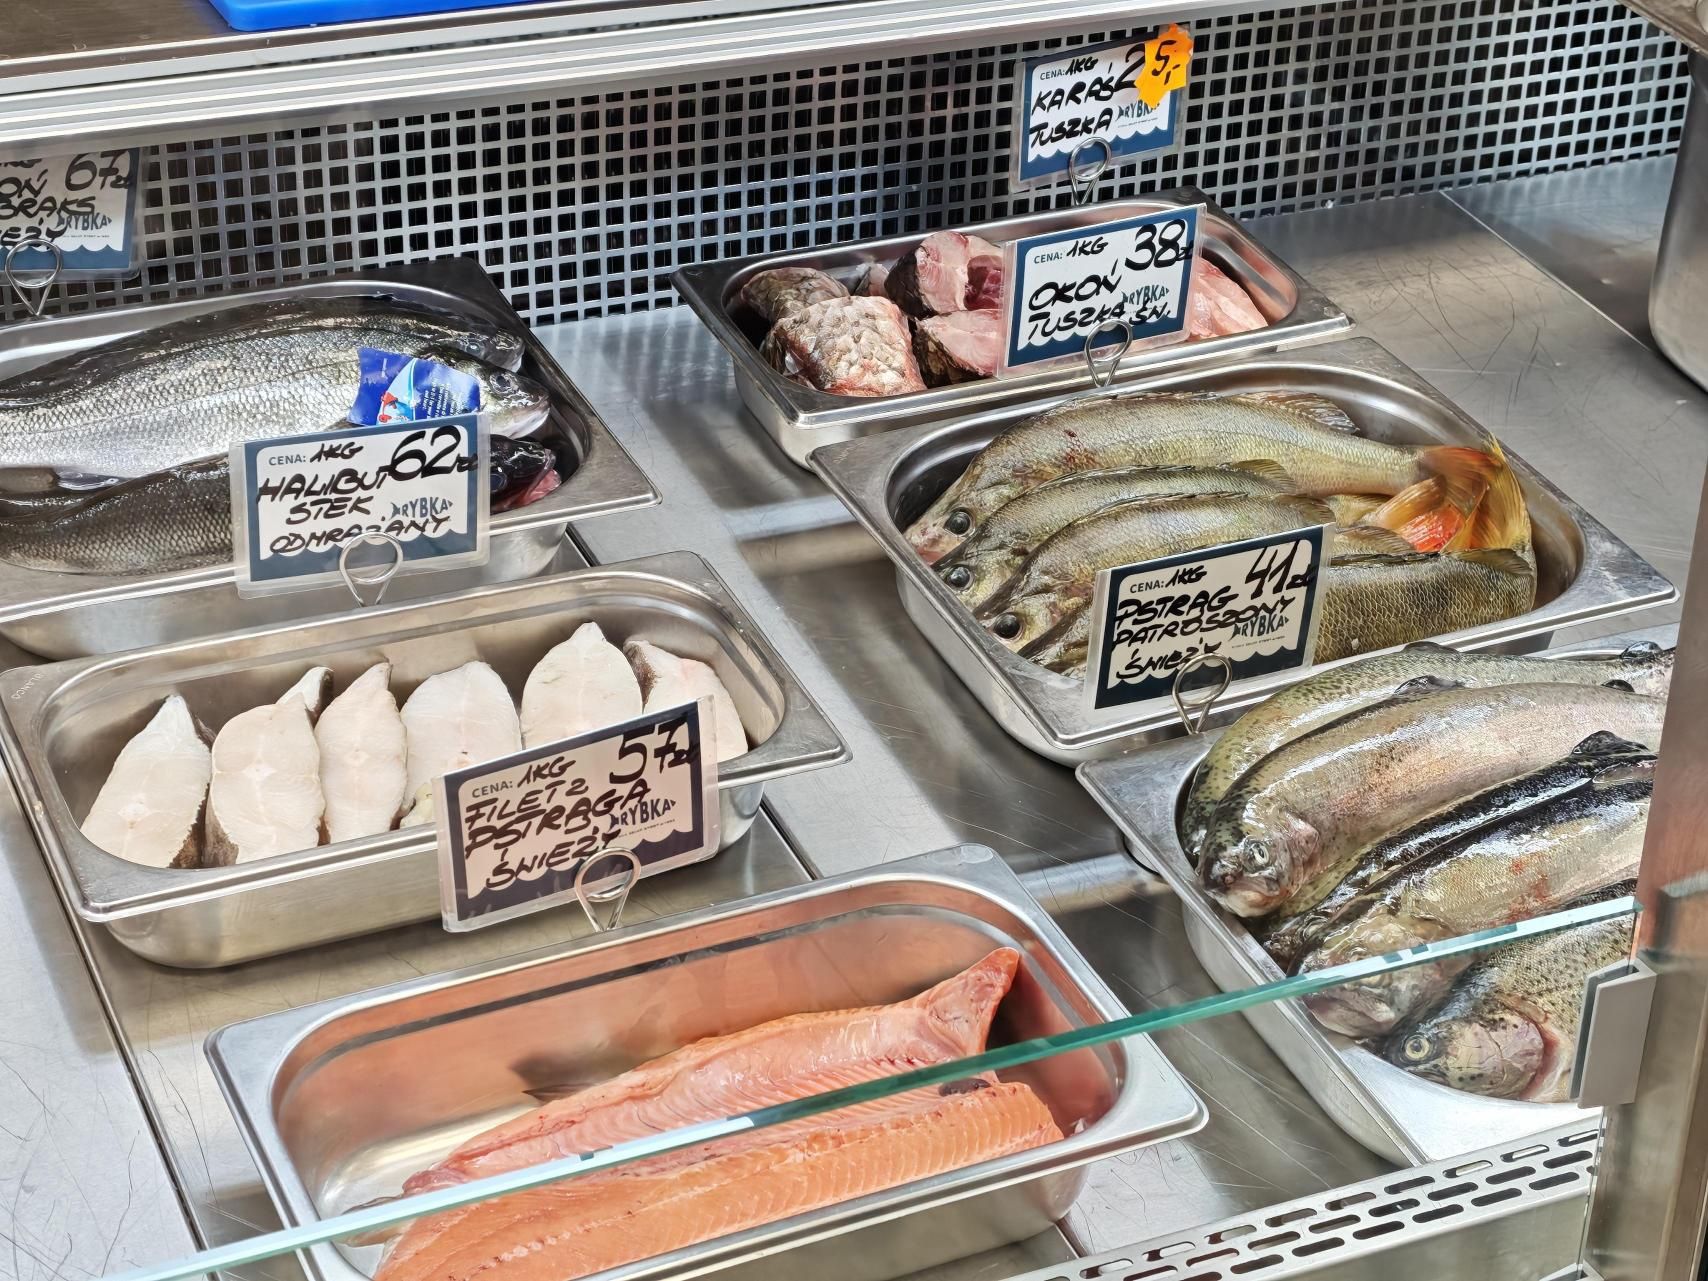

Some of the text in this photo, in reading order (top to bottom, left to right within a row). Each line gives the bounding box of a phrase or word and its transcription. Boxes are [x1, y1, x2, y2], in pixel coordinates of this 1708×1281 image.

[1040, 56, 1099, 81] CENA: 1KG
[1028, 107, 1114, 149] TUSZKA
[66, 212, 108, 231] RYBKA
[1034, 236, 1109, 264] CENA: 1KG
[1129, 285, 1165, 305] RYBKA
[1027, 301, 1125, 340] TUSZKA
[268, 441, 364, 466] CENA: 1KG
[256, 465, 392, 504] HALIBUT
[285, 496, 374, 526] STEK
[401, 497, 449, 518] RYBKA
[1130, 565, 1208, 594] CENA: 1KG
[1113, 596, 1296, 648] PATROSZONY
[1241, 613, 1284, 637] RYBKA
[472, 756, 576, 799] CENA: 1KG
[465, 780, 566, 830] FILET
[621, 799, 671, 827] RYBKA
